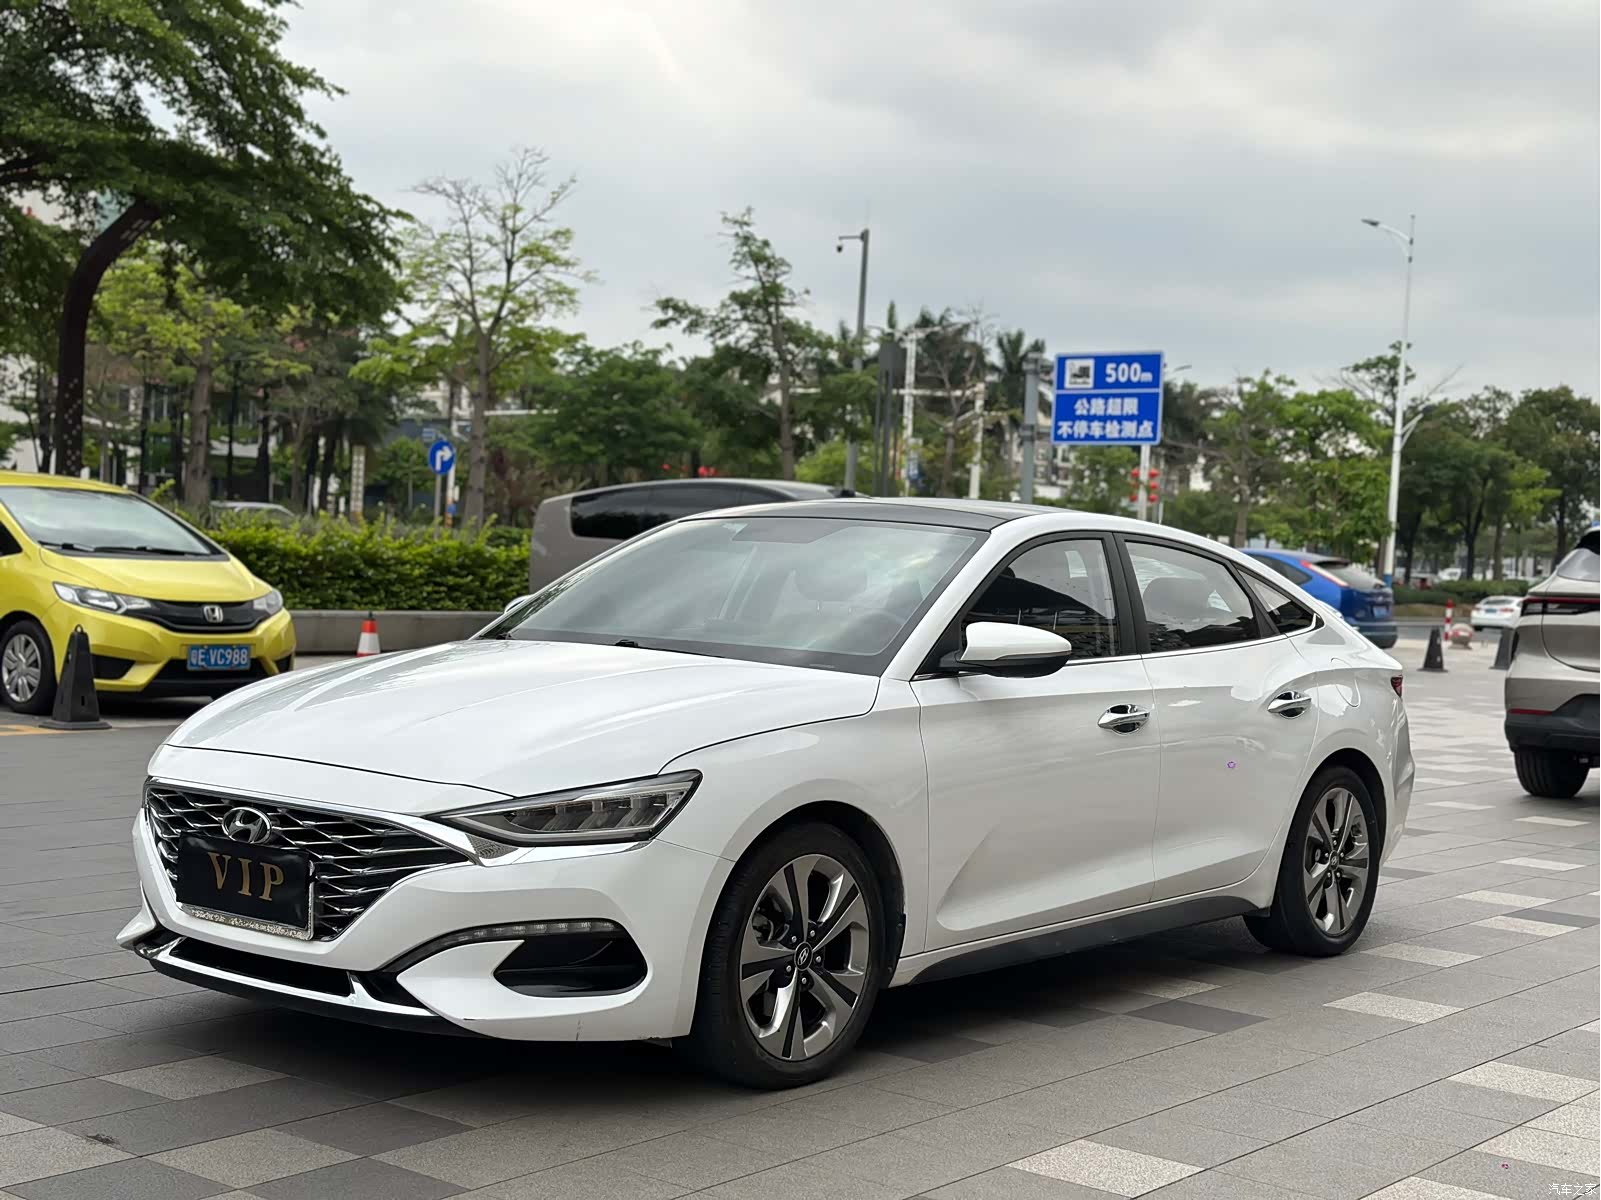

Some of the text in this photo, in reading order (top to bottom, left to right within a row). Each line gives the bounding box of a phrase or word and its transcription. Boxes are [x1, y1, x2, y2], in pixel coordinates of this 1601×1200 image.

[1105, 362, 1153, 383] 500m
[1074, 397, 1139, 416] 公路超限
[1057, 420, 1154, 439] 不停车检测点
[207, 851, 285, 901] VIP
